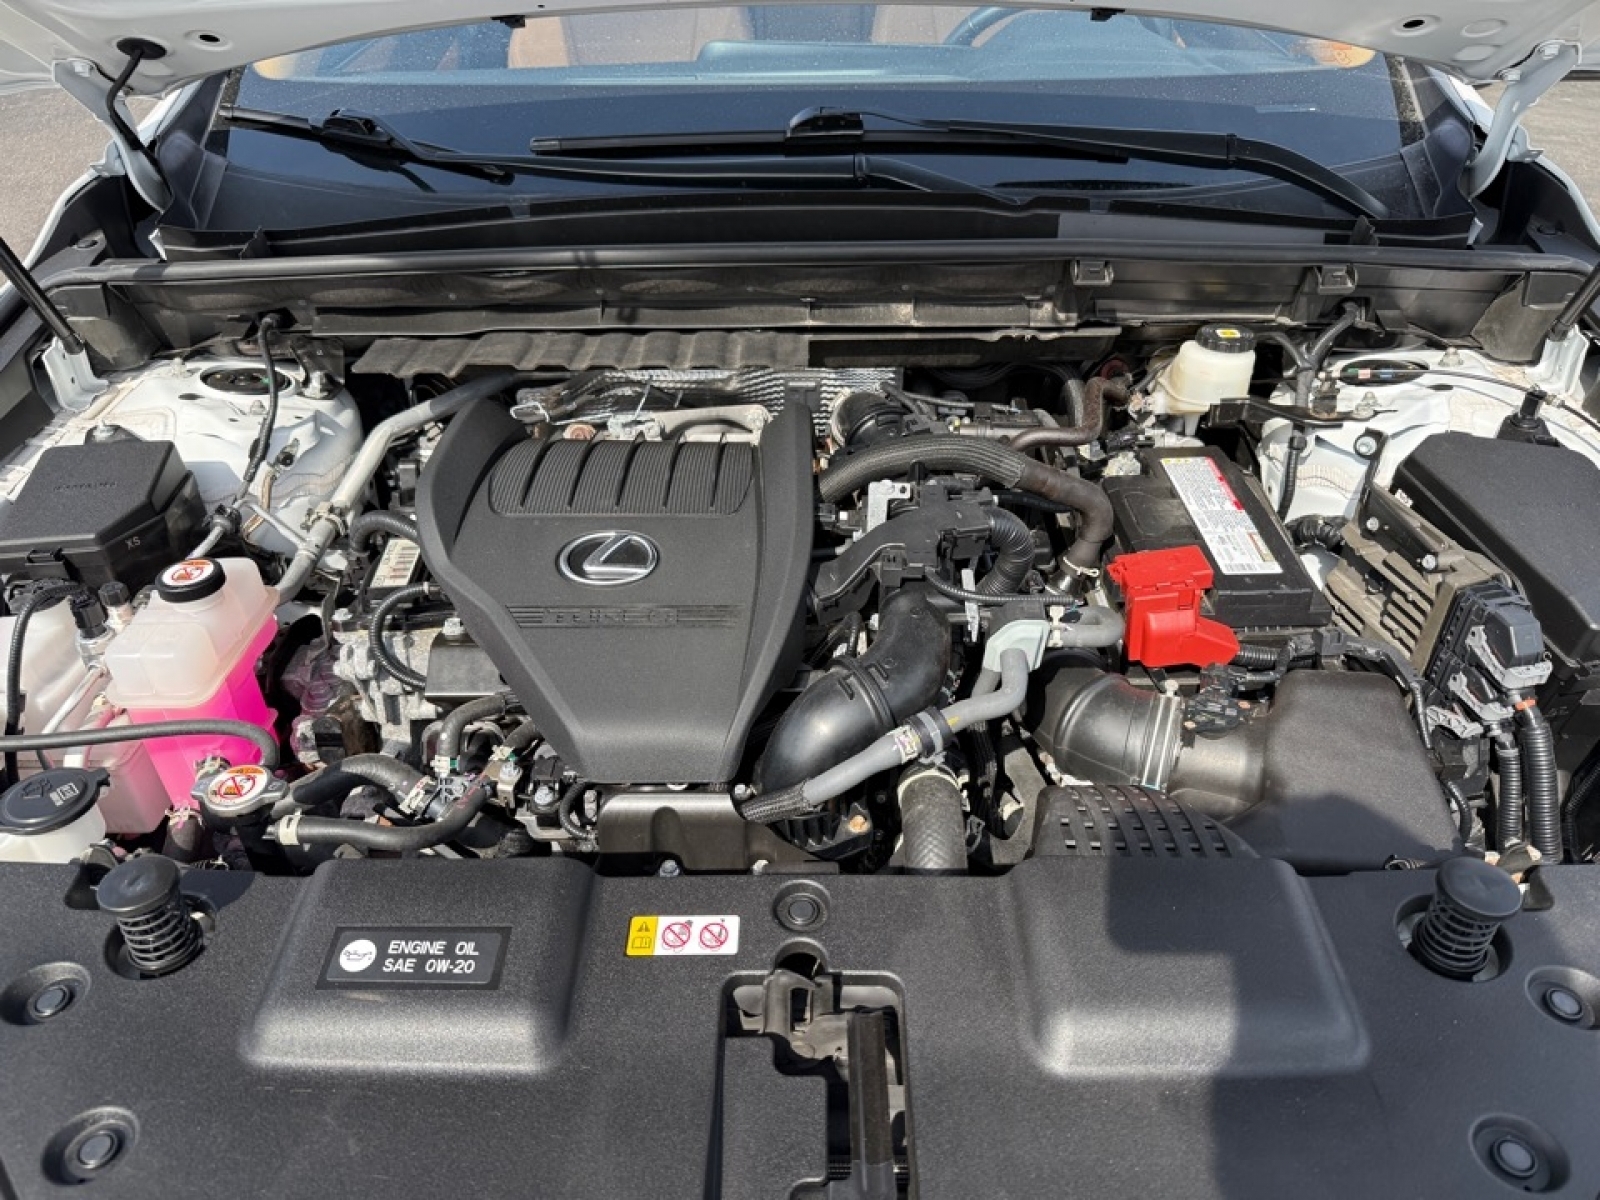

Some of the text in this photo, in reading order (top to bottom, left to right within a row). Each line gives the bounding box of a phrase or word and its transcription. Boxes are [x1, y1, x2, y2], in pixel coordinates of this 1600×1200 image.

[387, 940, 480, 956] ENGINE OIL
[382, 958, 476, 974] SAE 0W-20
